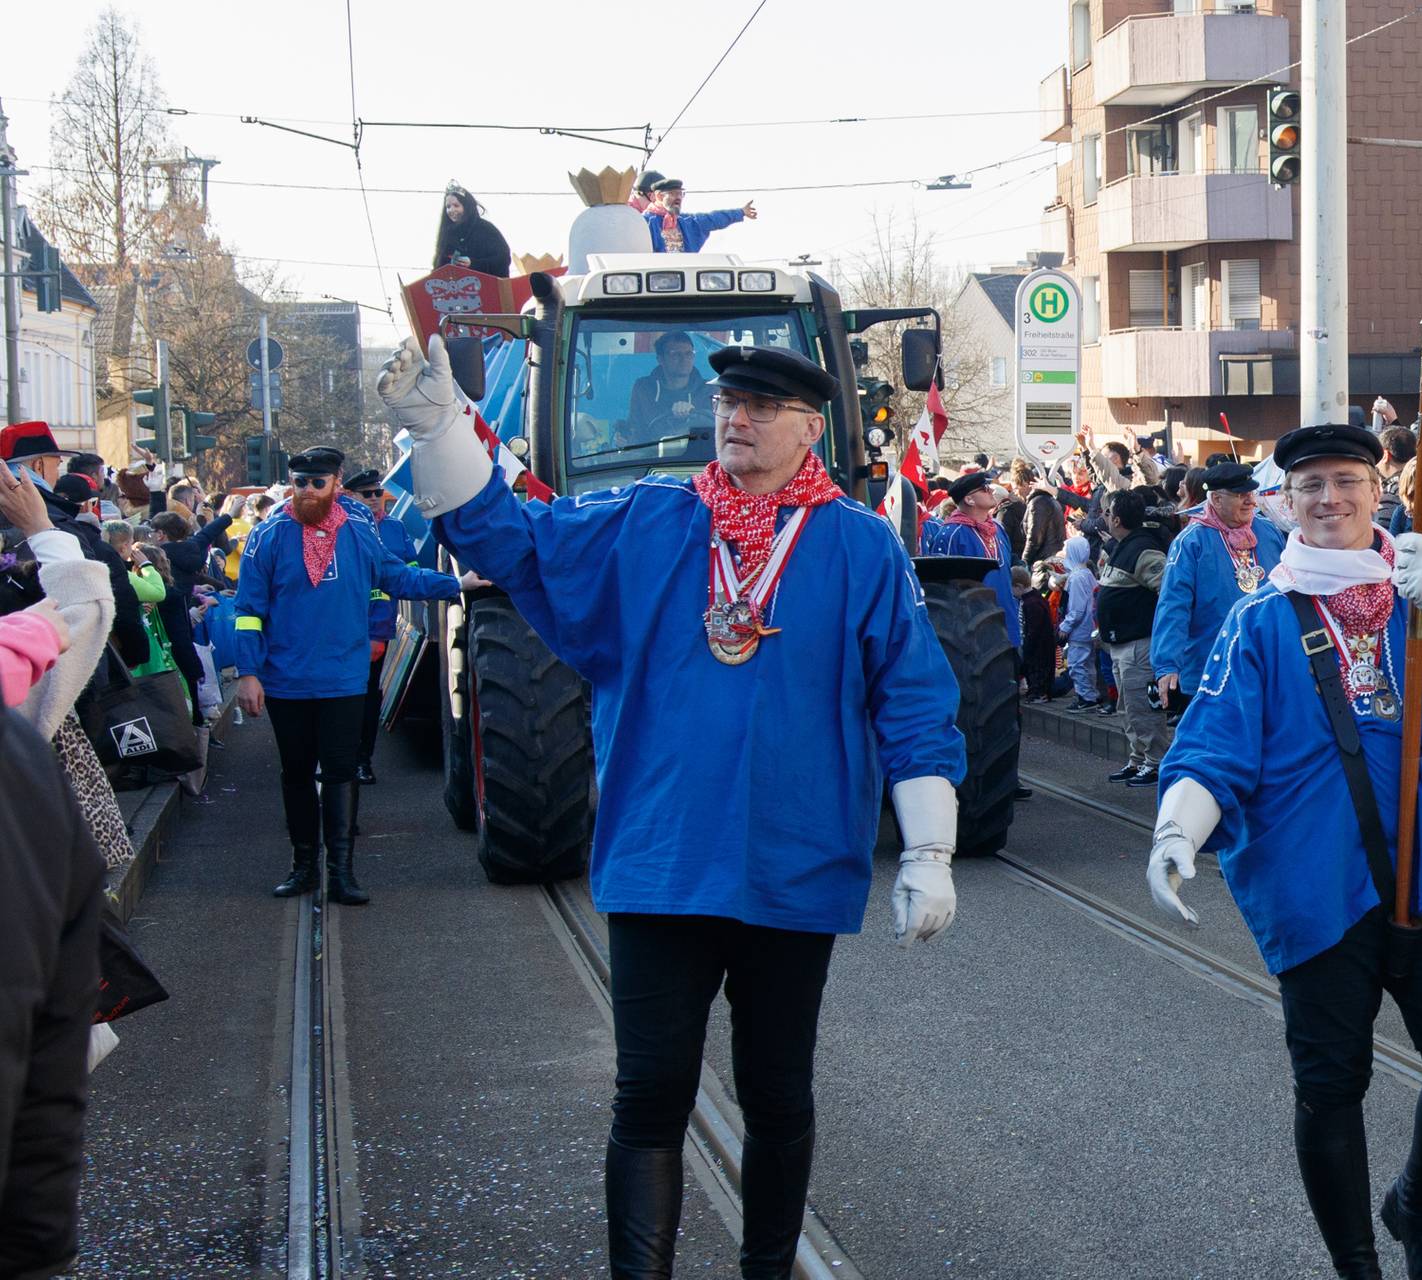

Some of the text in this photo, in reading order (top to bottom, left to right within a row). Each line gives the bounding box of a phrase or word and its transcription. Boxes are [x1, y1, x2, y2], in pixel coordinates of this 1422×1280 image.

[1041, 292, 1058, 314] H
[1023, 312, 1031, 324] 3
[1024, 330, 1074, 339] Freiheitstraße
[1023, 349, 1038, 358] 302
[126, 743, 151, 754] ALDI
